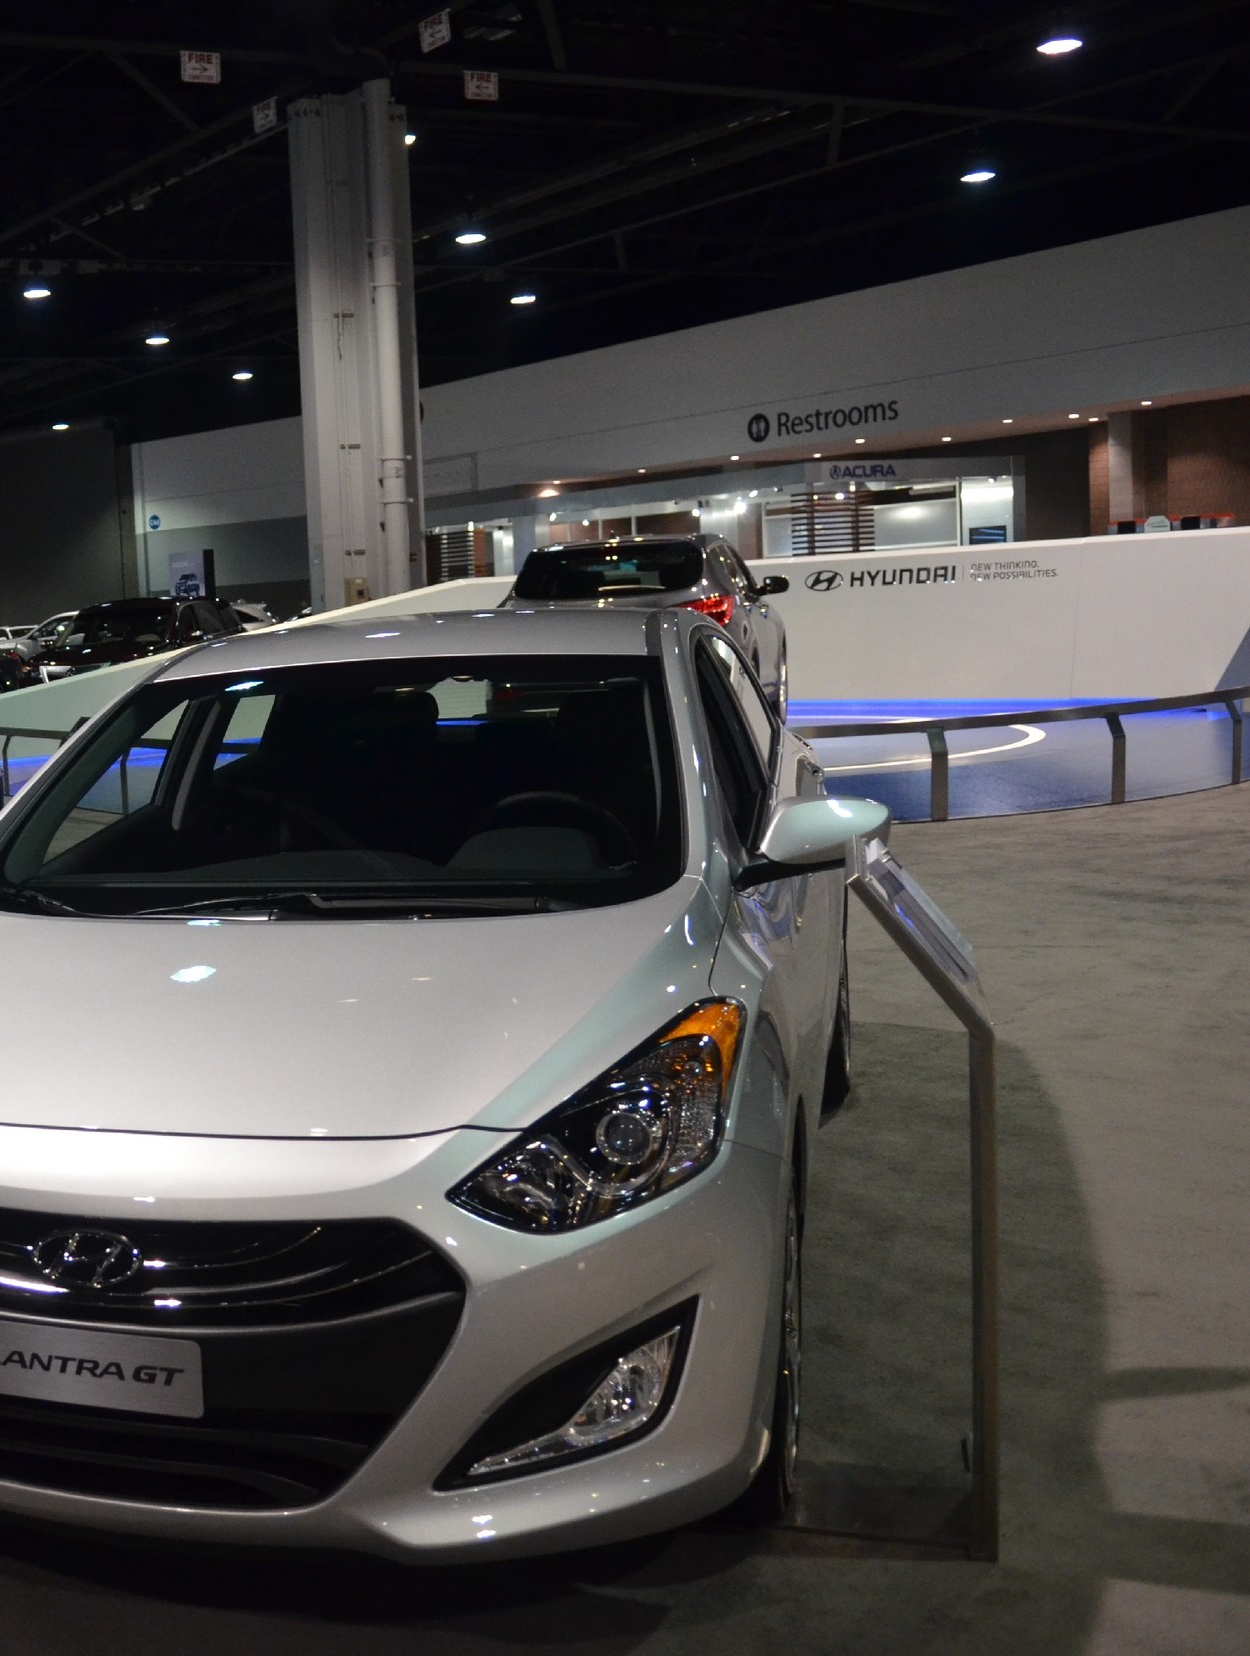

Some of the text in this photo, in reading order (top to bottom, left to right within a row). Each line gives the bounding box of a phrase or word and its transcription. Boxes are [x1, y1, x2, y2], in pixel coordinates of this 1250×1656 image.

[188, 53, 214, 64] FIRE
[470, 72, 492, 82] FIRE
[777, 400, 899, 437] Restrooms
[841, 464, 896, 478] ACURA
[971, 560, 1040, 571] NEW THINKING.
[850, 565, 956, 587] HYUNDAI
[132, 1364, 185, 1387] GT
